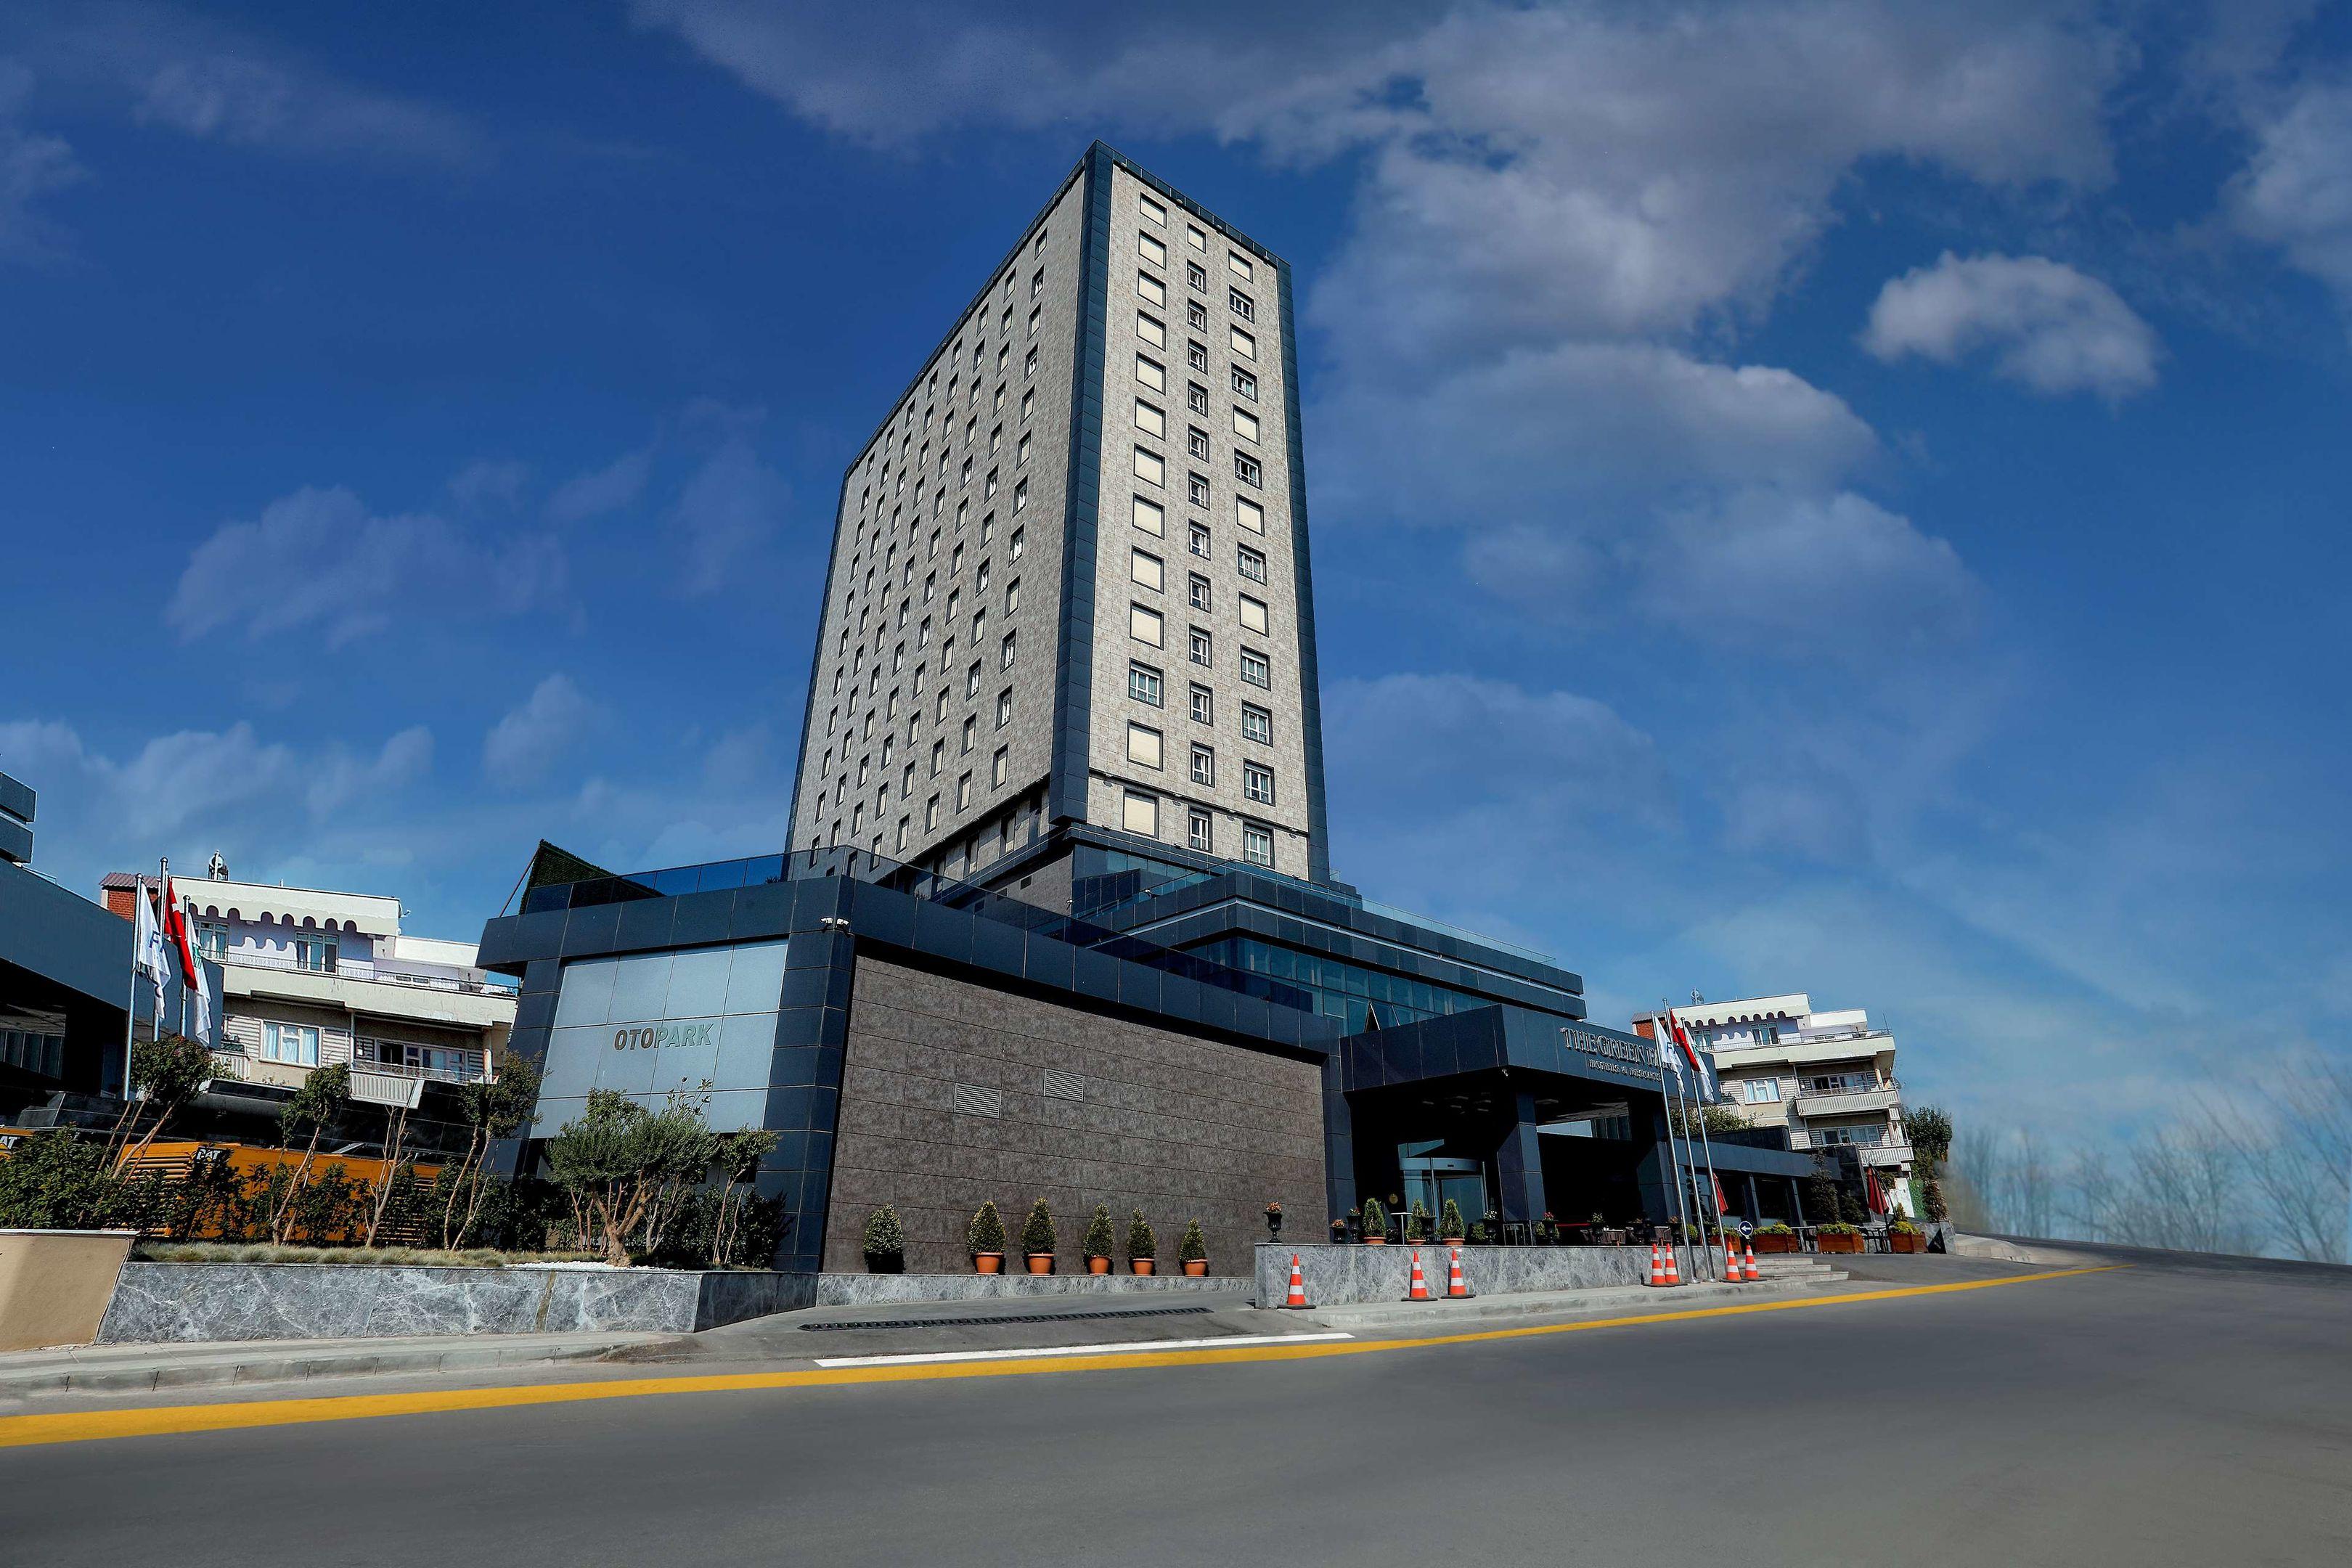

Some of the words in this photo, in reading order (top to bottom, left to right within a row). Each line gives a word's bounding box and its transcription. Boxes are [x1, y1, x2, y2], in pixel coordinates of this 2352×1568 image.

[614, 1023, 714, 1051] OTOPARK
[1560, 1027, 1598, 1055] THE
[1596, 1035, 1645, 1065] GREEN
[1588, 1059, 1620, 1073] HOTELS
[1622, 1065, 1628, 1074] &
